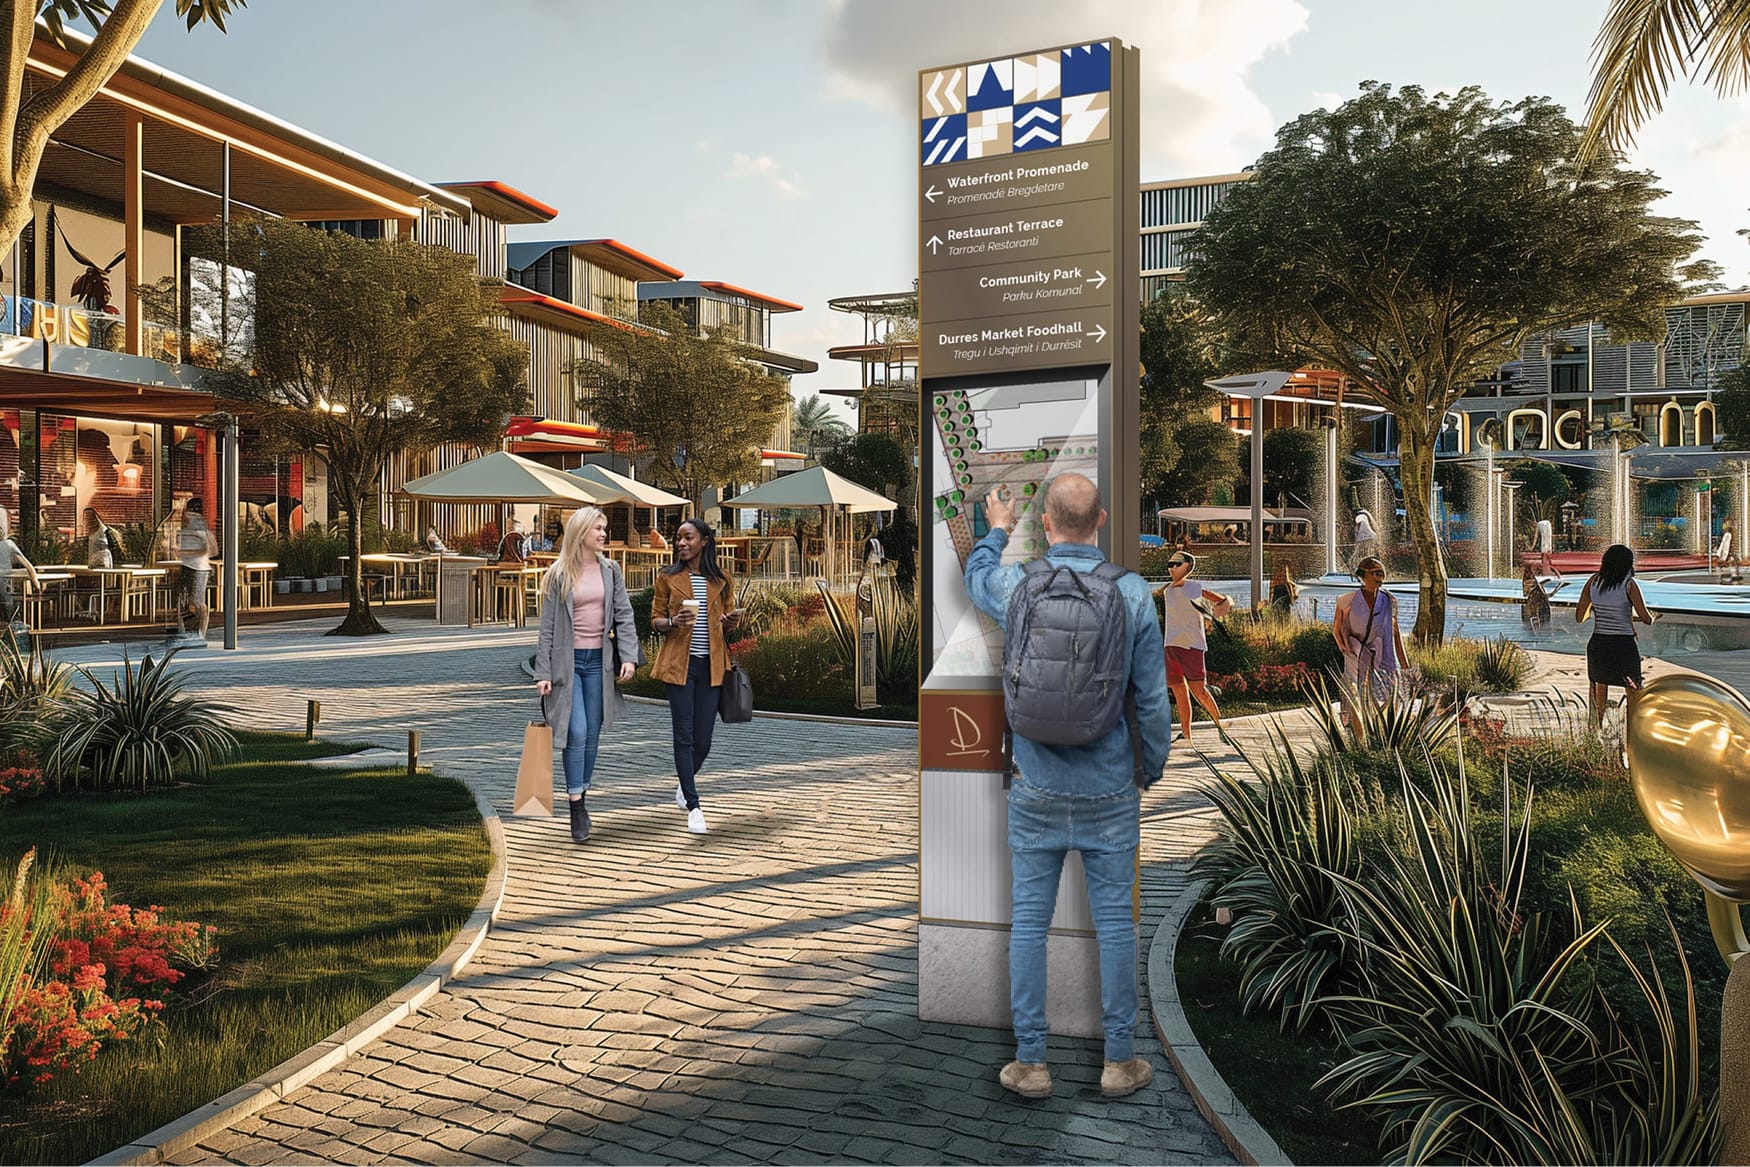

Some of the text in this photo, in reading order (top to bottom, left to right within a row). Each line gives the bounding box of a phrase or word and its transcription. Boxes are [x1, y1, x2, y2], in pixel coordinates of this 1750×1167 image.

[947, 160, 1089, 188] Waterfront Promenade
[1007, 182, 1065, 198] Bregdetare
[948, 218, 1064, 241] Restaurant Terrace
[987, 236, 1040, 252] Restoranti
[979, 267, 1083, 289] Community Park
[1002, 284, 1083, 303] Parku Komunal
[939, 321, 1083, 346] Durres Market Foodhall
[953, 348, 981, 361] Tregu
[982, 346, 987, 357] i
[988, 343, 1034, 358] Ushqimit
[1035, 342, 1041, 353] i
